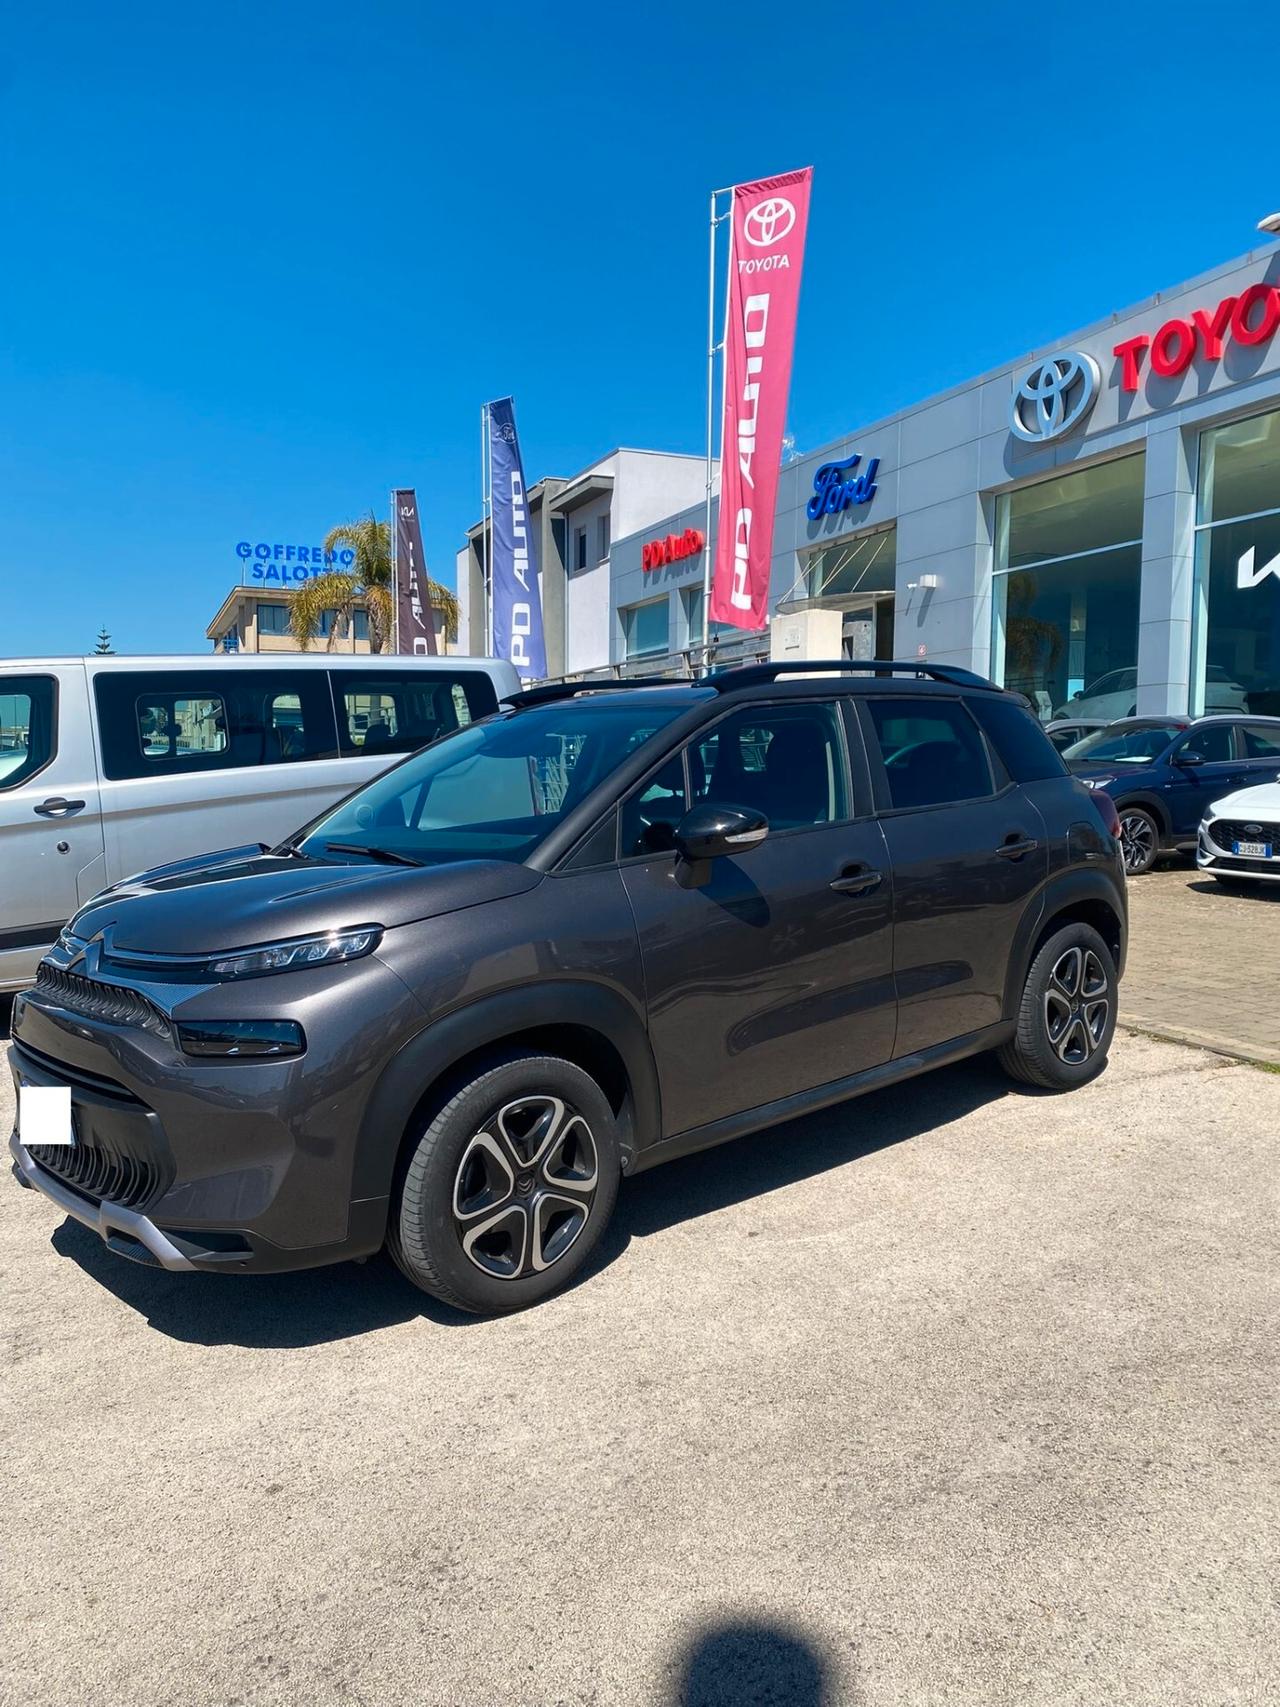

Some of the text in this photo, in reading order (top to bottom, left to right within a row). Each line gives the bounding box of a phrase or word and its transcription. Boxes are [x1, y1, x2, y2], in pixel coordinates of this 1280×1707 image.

[738, 254, 790, 274] TOYOTA
[1113, 277, 1280, 392] TOYO
[806, 453, 881, 520] Ford
[235, 541, 355, 565] GOFFREDO
[252, 562, 344, 581] SALOT
[511, 471, 531, 668] PD AUTO
